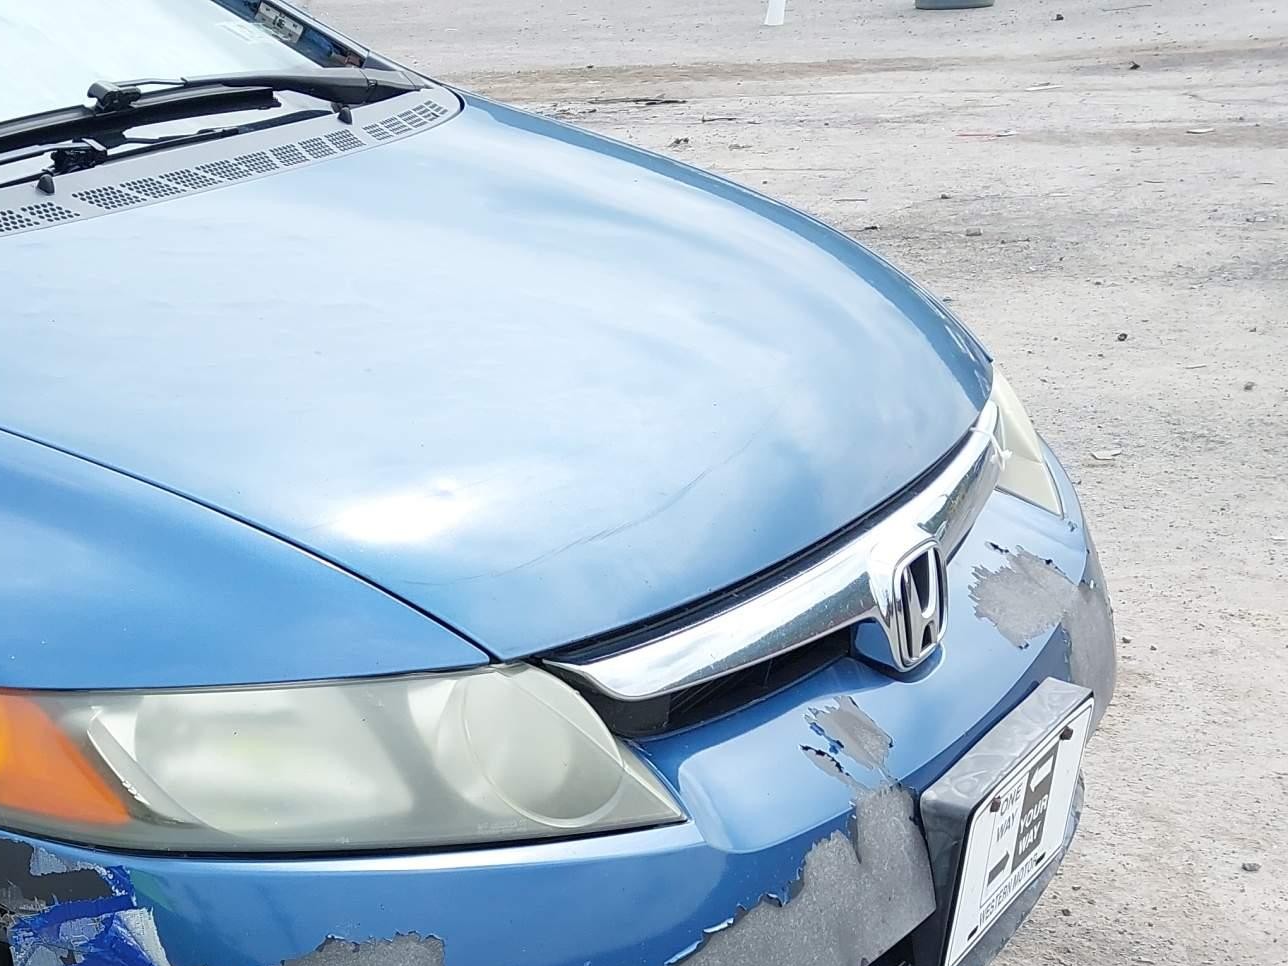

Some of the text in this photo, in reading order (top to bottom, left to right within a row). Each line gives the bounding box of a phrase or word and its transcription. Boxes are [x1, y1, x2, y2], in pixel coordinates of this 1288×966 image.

[1001, 781, 1023, 817] ONE
[1020, 793, 1049, 834] YOUR
[997, 807, 1019, 843] WAY
[1018, 820, 1042, 856] WAY
[979, 877, 1013, 929] WESTERN
